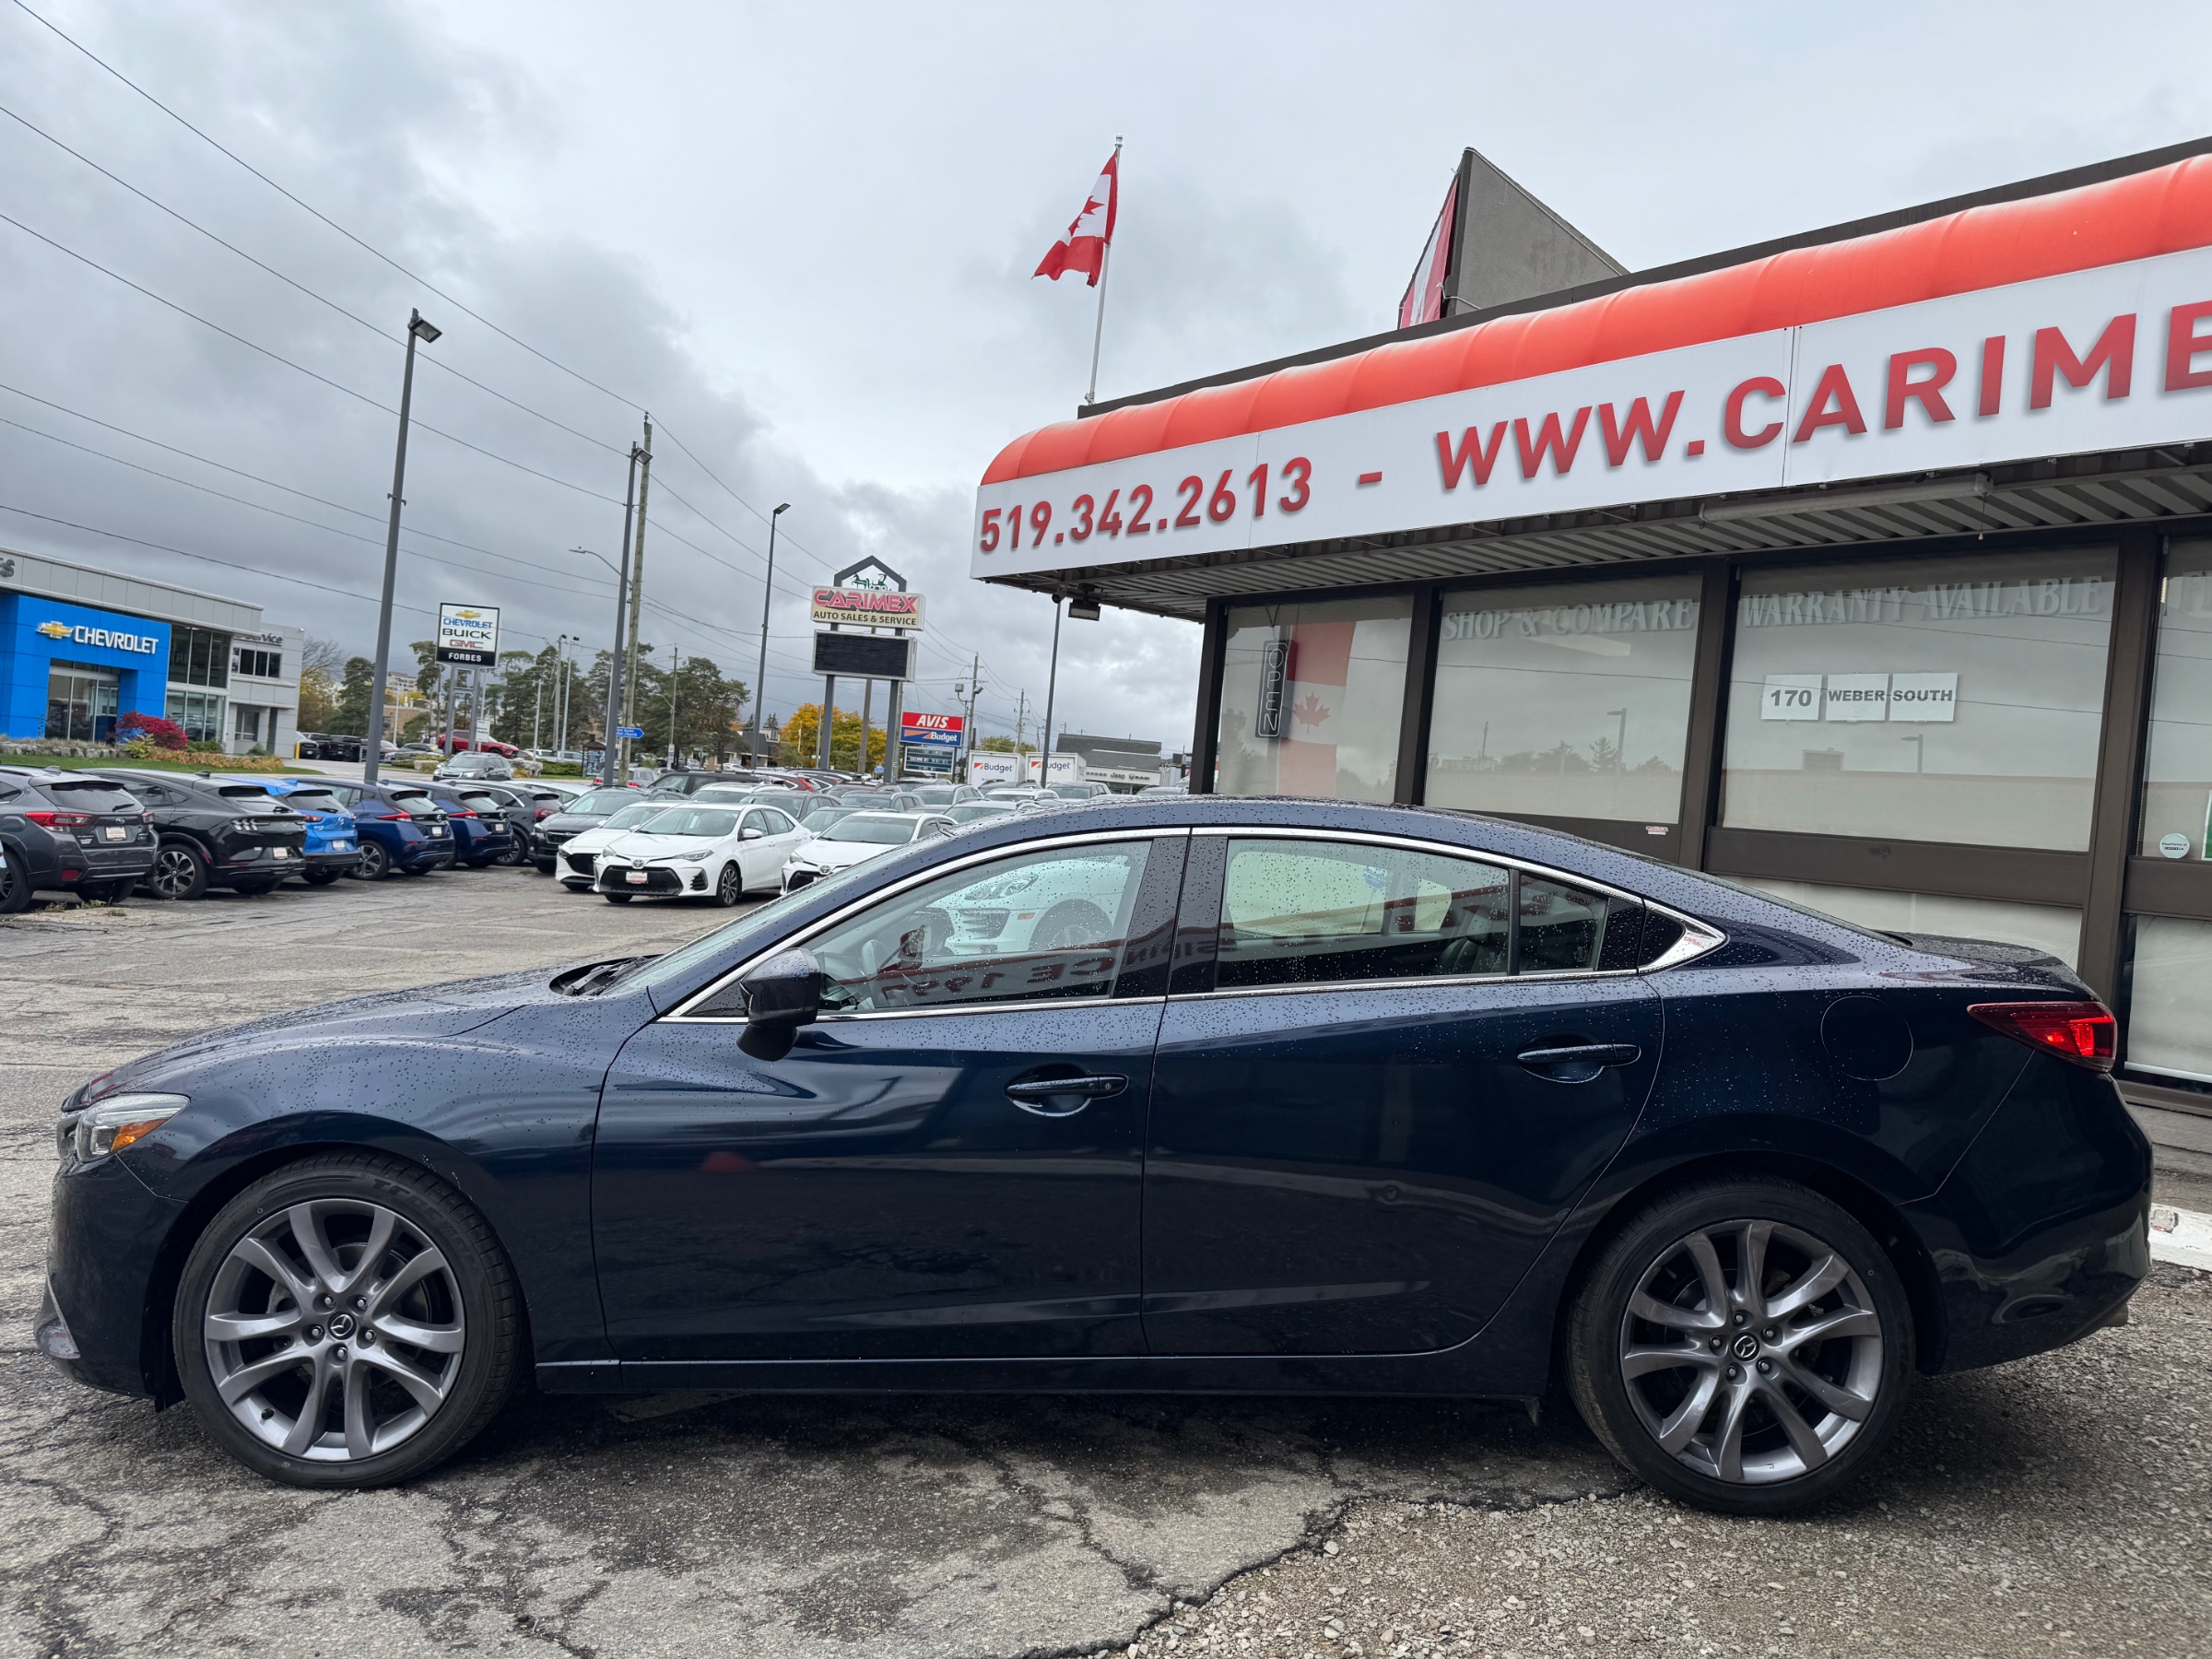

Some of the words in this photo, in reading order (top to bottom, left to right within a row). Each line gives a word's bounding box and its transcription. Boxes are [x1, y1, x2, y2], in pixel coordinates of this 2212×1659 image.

[980, 456, 1312, 552] 519.342.2613
[814, 590, 919, 613] CARIMEX
[1743, 585, 1911, 627] WARRANTY
[1920, 575, 2103, 620] AVAILABLE
[443, 618, 493, 629] CHEVROLET
[813, 610, 839, 620] AUTO
[841, 613, 868, 623] SALES
[870, 615, 877, 623] &
[879, 616, 917, 626] SERVICE
[1443, 608, 1512, 641] SHOP
[1521, 607, 1537, 637] &
[1550, 599, 1693, 635] COMPARE
[74, 625, 159, 653] CHEVROLET
[442, 628, 492, 640] BUICK
[450, 639, 484, 649] GMC
[448, 652, 482, 662] FORBES
[1263, 648, 1284, 731] OPEN
[1771, 688, 1813, 707] 170
[1828, 689, 1886, 702] WEBER
[1892, 688, 1953, 702] SOUTH
[916, 714, 949, 729] AVIS
[931, 731, 958, 743] Budget
[983, 762, 1013, 773] Budget
[1046, 762, 1070, 771] udget
